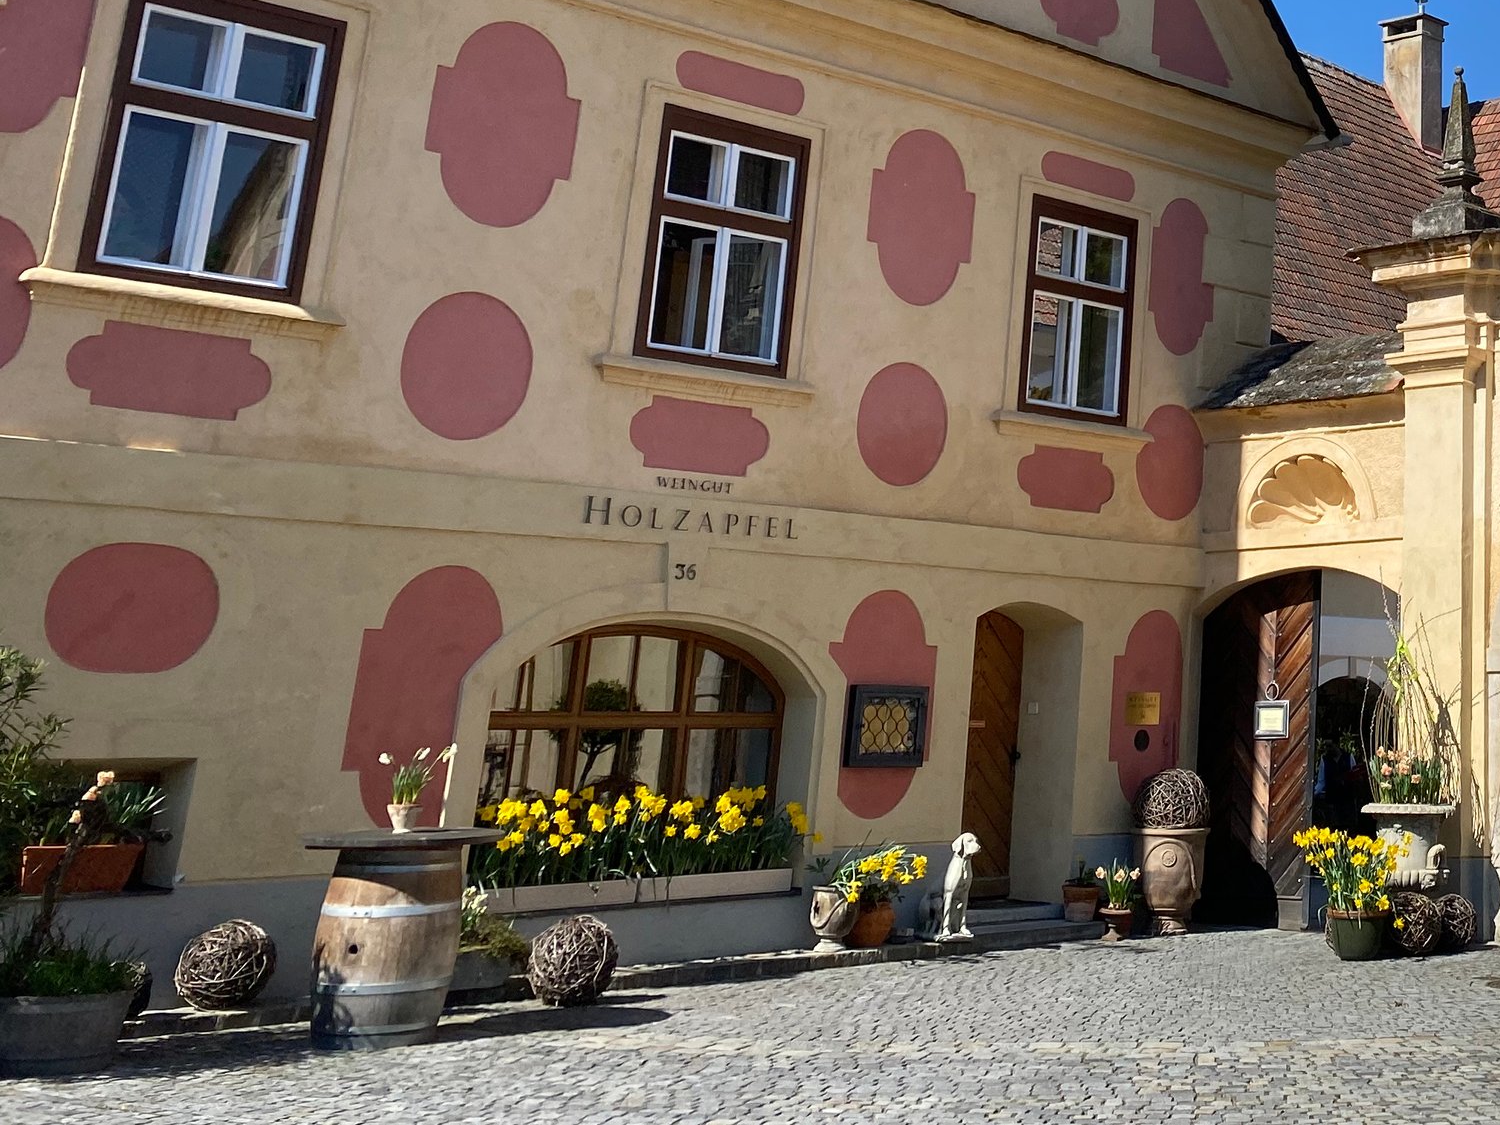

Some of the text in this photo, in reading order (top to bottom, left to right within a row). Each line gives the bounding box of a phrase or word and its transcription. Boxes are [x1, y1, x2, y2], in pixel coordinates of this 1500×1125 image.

[656, 476, 734, 494] WEINGUT
[584, 495, 798, 540] HOLZAPFEL
[674, 563, 697, 581] 36
